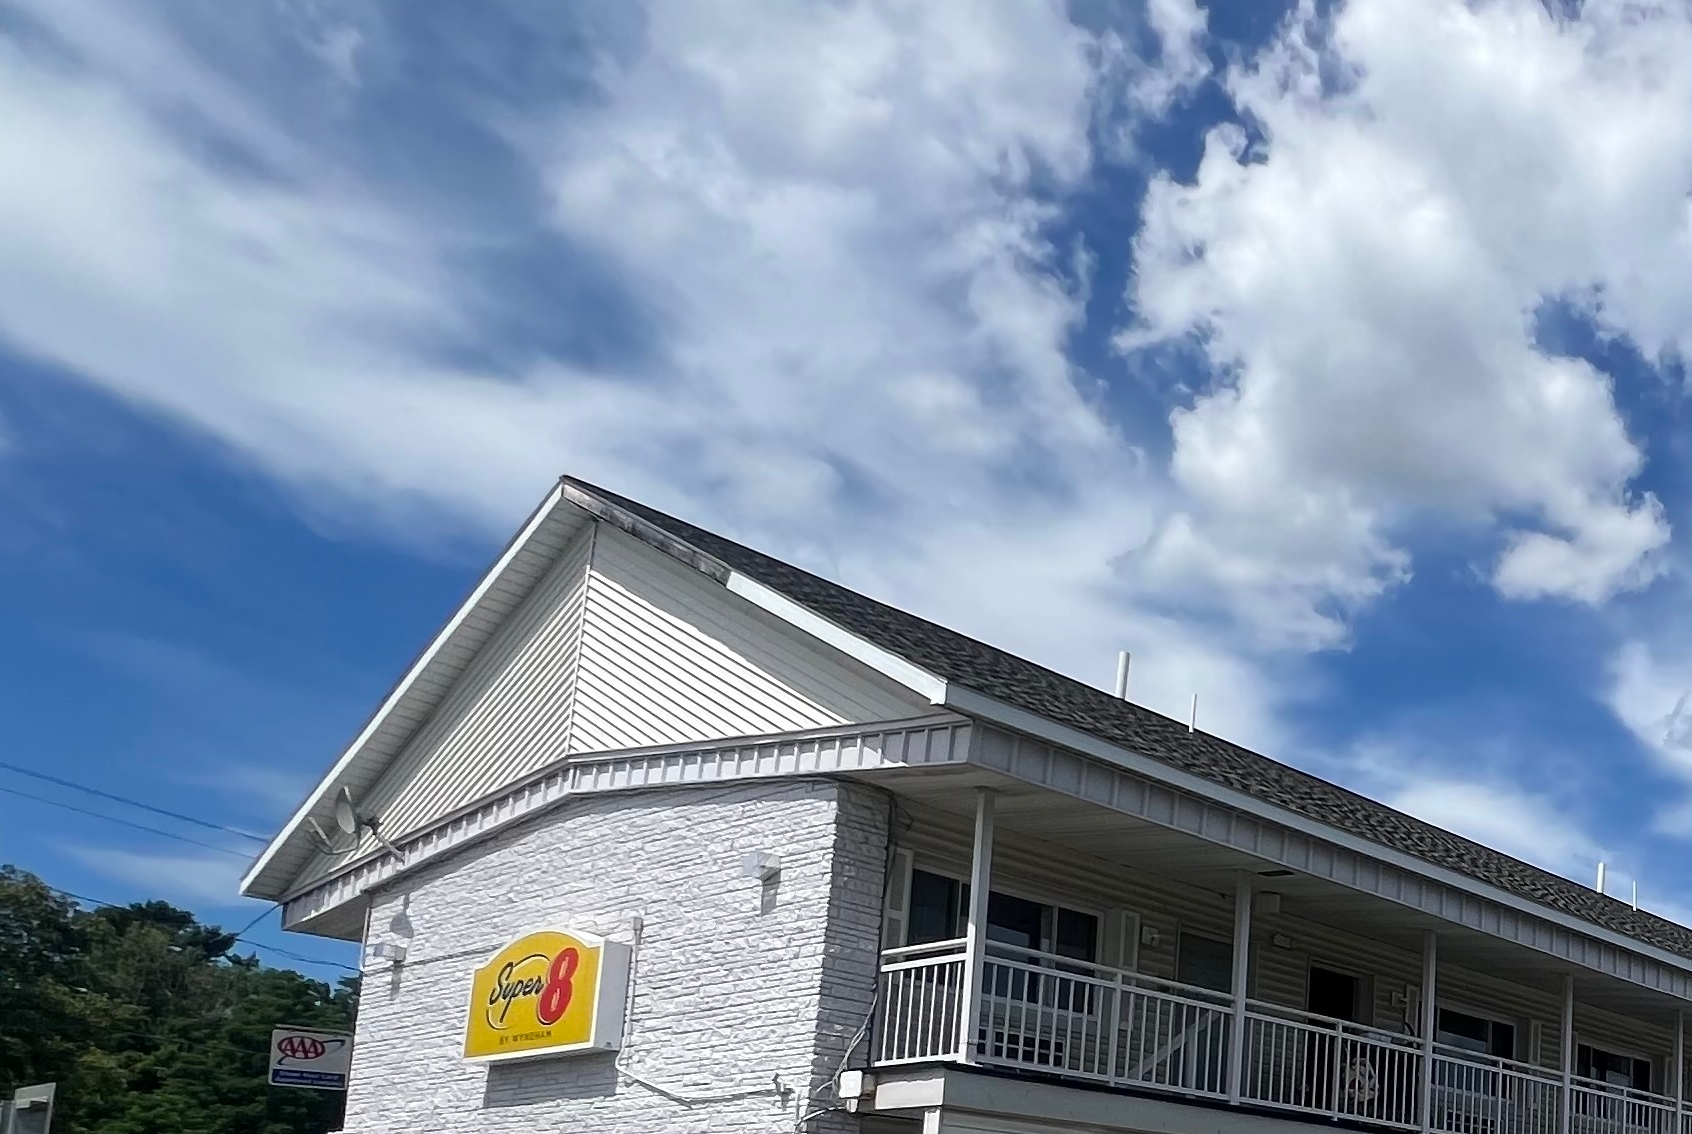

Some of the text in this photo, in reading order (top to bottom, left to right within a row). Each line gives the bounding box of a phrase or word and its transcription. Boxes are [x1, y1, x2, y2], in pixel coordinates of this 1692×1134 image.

[489, 947, 579, 1025] Super 8
[281, 1037, 322, 1059] AAA
